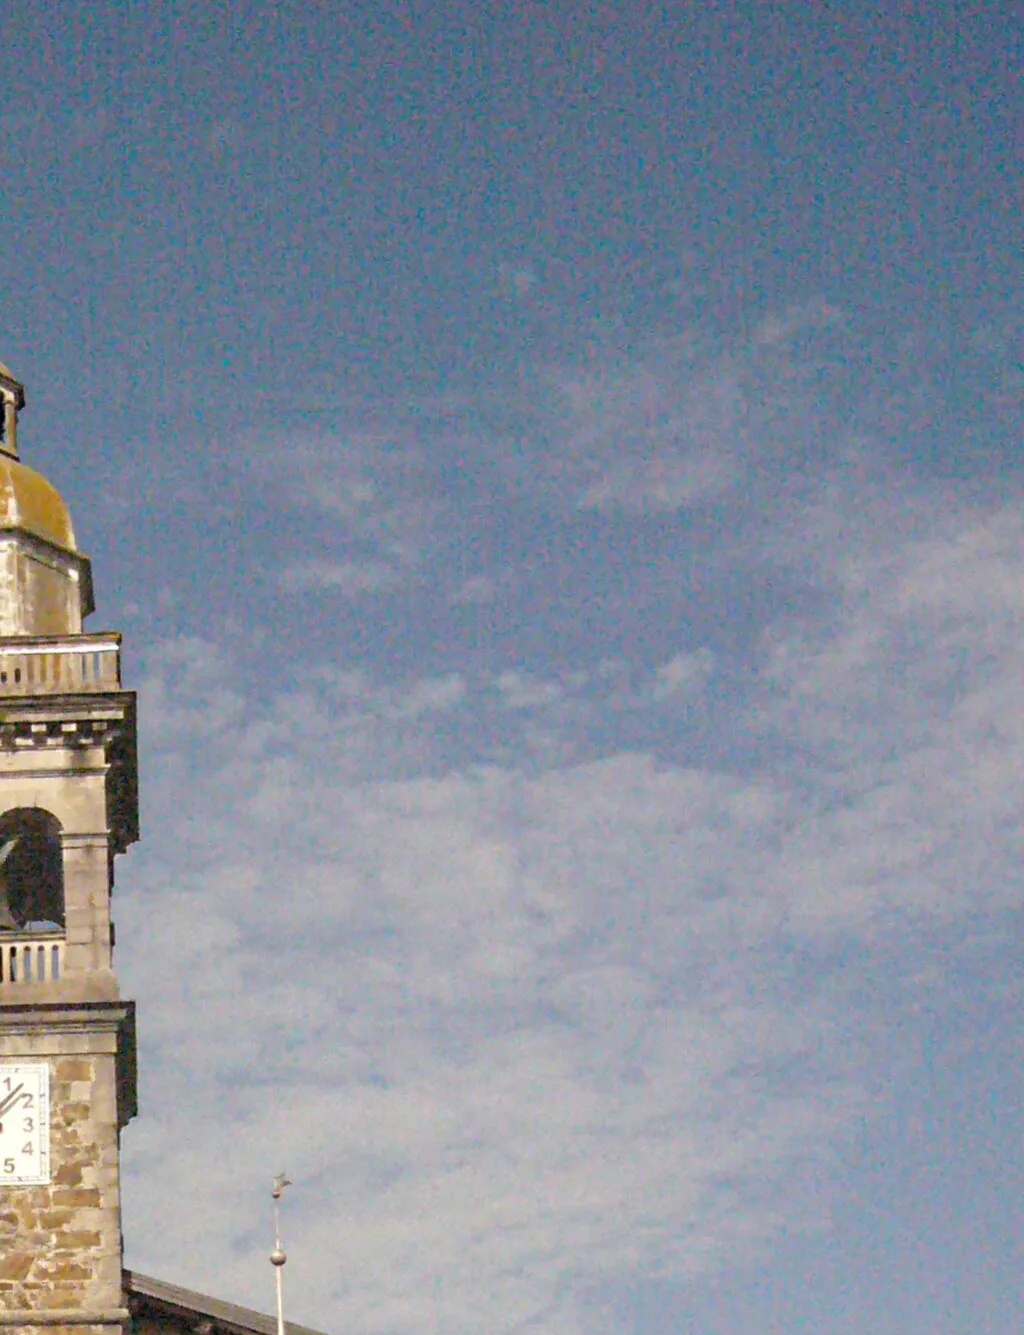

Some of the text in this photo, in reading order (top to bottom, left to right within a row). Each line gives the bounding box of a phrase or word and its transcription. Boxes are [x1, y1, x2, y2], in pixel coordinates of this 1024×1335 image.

[3, 1077, 12, 1091] 1
[22, 1093, 34, 1109] 2
[23, 1117, 34, 1133] 3
[21, 1141, 34, 1156] 4
[4, 1158, 15, 1174] 5
